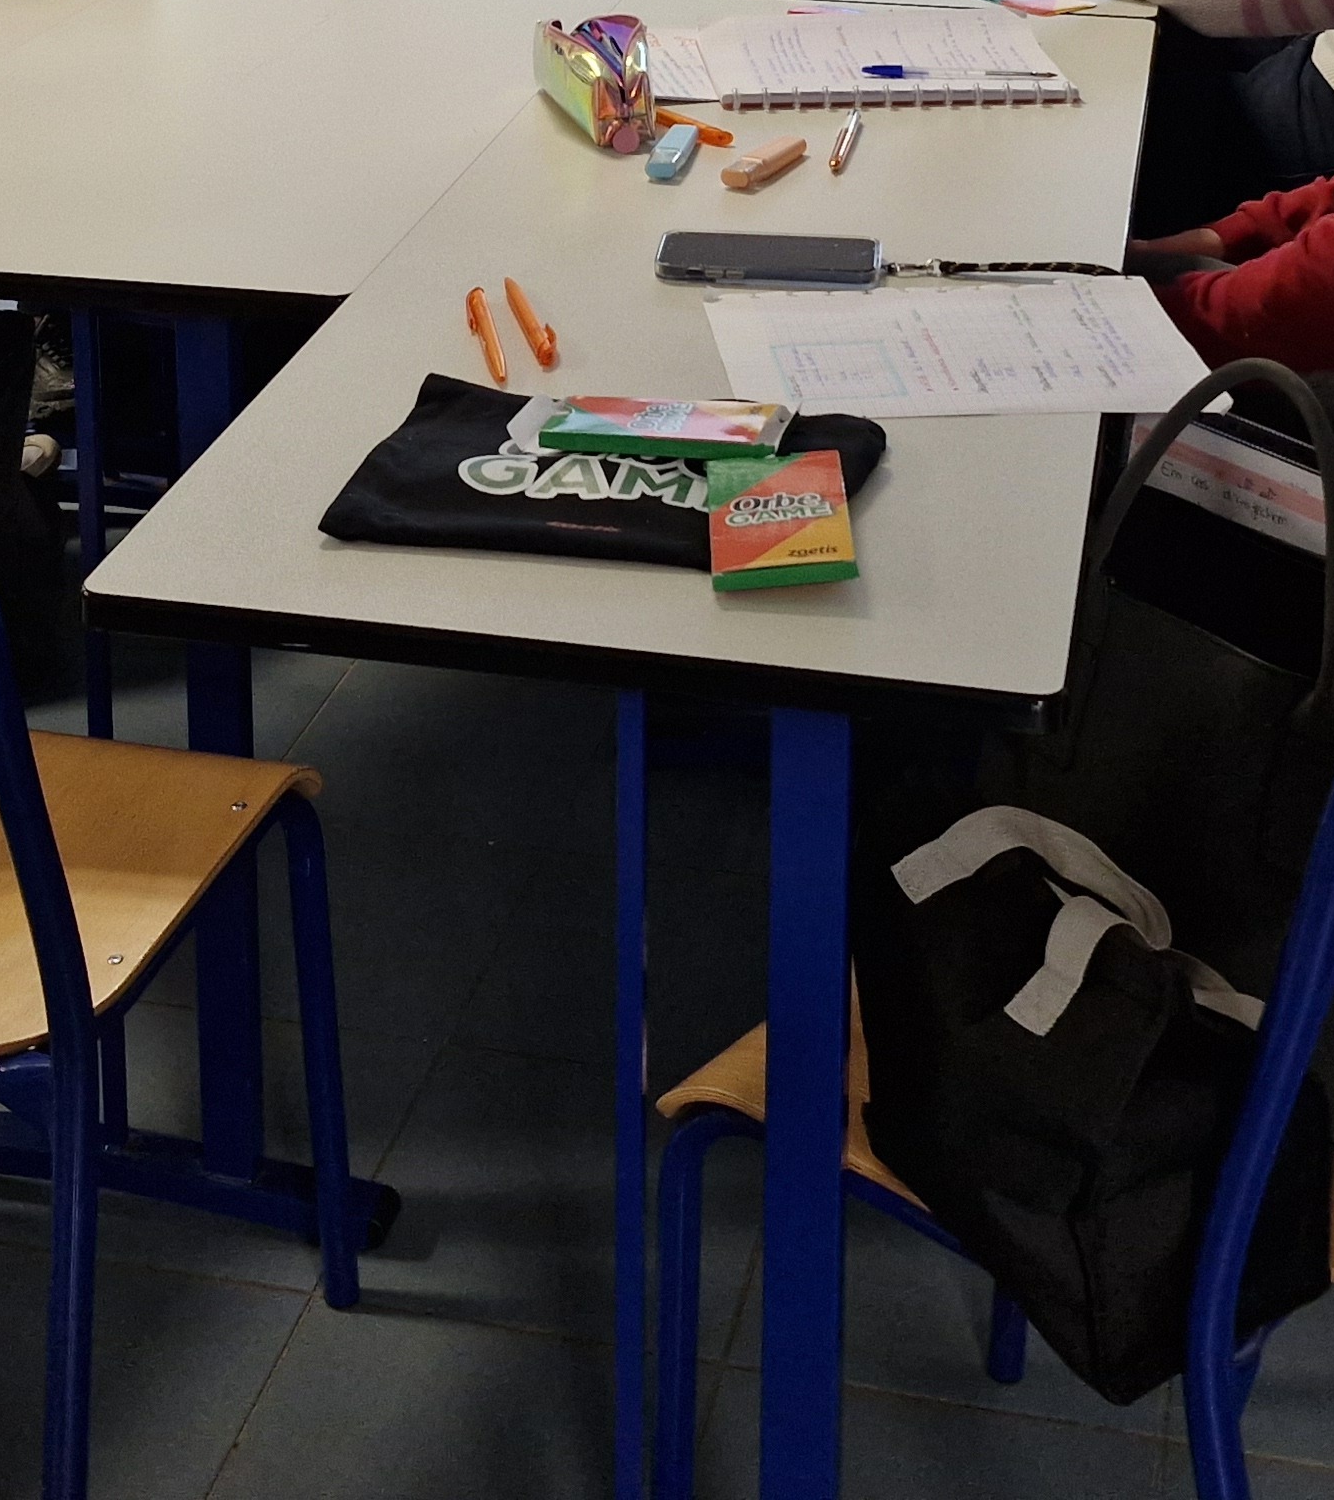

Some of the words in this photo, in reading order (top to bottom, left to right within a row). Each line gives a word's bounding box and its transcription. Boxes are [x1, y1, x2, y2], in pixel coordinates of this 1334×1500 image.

[458, 453, 708, 512] GAM
[725, 501, 834, 527] GAME
[730, 492, 822, 513] Orbe
[788, 544, 838, 558] zoetis
